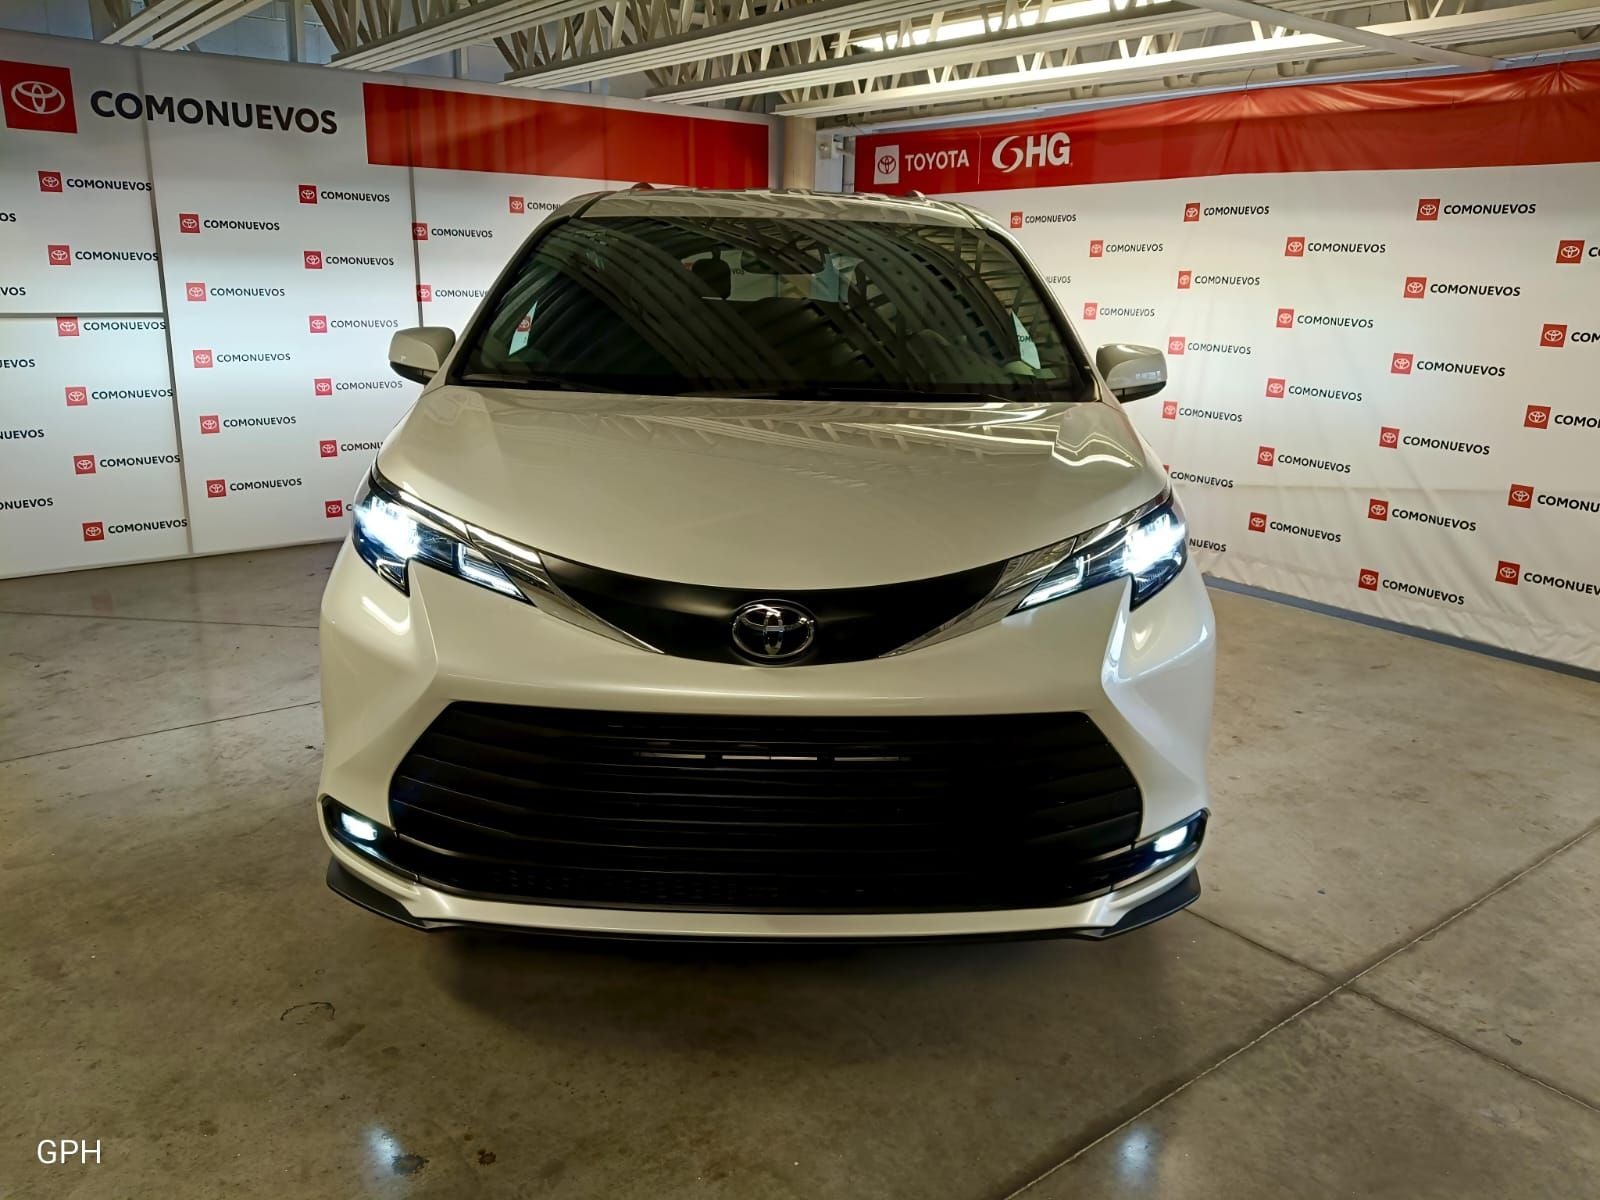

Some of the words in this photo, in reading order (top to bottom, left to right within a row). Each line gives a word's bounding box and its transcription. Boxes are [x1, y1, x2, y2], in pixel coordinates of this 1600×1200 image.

[90, 90, 338, 135] COMONUEVOS
[905, 149, 970, 172] TOYOTA
[66, 178, 152, 191] COMONUEVOS
[320, 190, 390, 203] COMONUEVOS
[1203, 205, 1270, 217] COMONUEVOS
[1443, 203, 1537, 215] COMONUEVOS
[203, 219, 280, 231] COMONUEVOS
[1024, 213, 1077, 224] COMONUEVOS
[430, 228, 493, 238] COMONUEVOS
[1105, 243, 1164, 253] COMONUEVOS
[1307, 242, 1386, 254] COMONUEVOS
[75, 250, 159, 262] COMONUEVOS
[325, 256, 395, 266] COMONUEVOS
[1194, 275, 1261, 286] COMONUEVOS
[209, 287, 286, 297] COMONUEVOS
[1430, 283, 1521, 297] COMONUEVOS
[1099, 307, 1155, 317] COMONUEVOS
[83, 320, 166, 331] COMONUEVOS
[330, 319, 399, 329] COMONUEVOS
[1297, 315, 1374, 329] COMONUEVOS
[1187, 341, 1252, 355] COMONUEVOS
[216, 352, 291, 363] COMONUEVOS
[1416, 360, 1506, 377] COMONUEVOS
[335, 380, 403, 390] COMONUEVOS
[91, 388, 173, 400] COMONUEVOS
[1288, 385, 1363, 402] COMONUEVOS
[1178, 407, 1243, 423] COMONUEVOS
[222, 416, 297, 428] COMONUEVOS
[1402, 435, 1491, 456] COMONUEVOS
[99, 454, 181, 469] COMONUEVOS
[1277, 454, 1351, 474] COMONUEVOS
[229, 477, 303, 492] COMONUEVOS
[1170, 471, 1234, 489] COMONUEVOS
[107, 518, 188, 534] COMONUEVOS
[1391, 508, 1477, 532] COMONUEVOS
[1269, 521, 1342, 543] COMONUEVOS
[1382, 579, 1465, 606] COMONUEVOS
